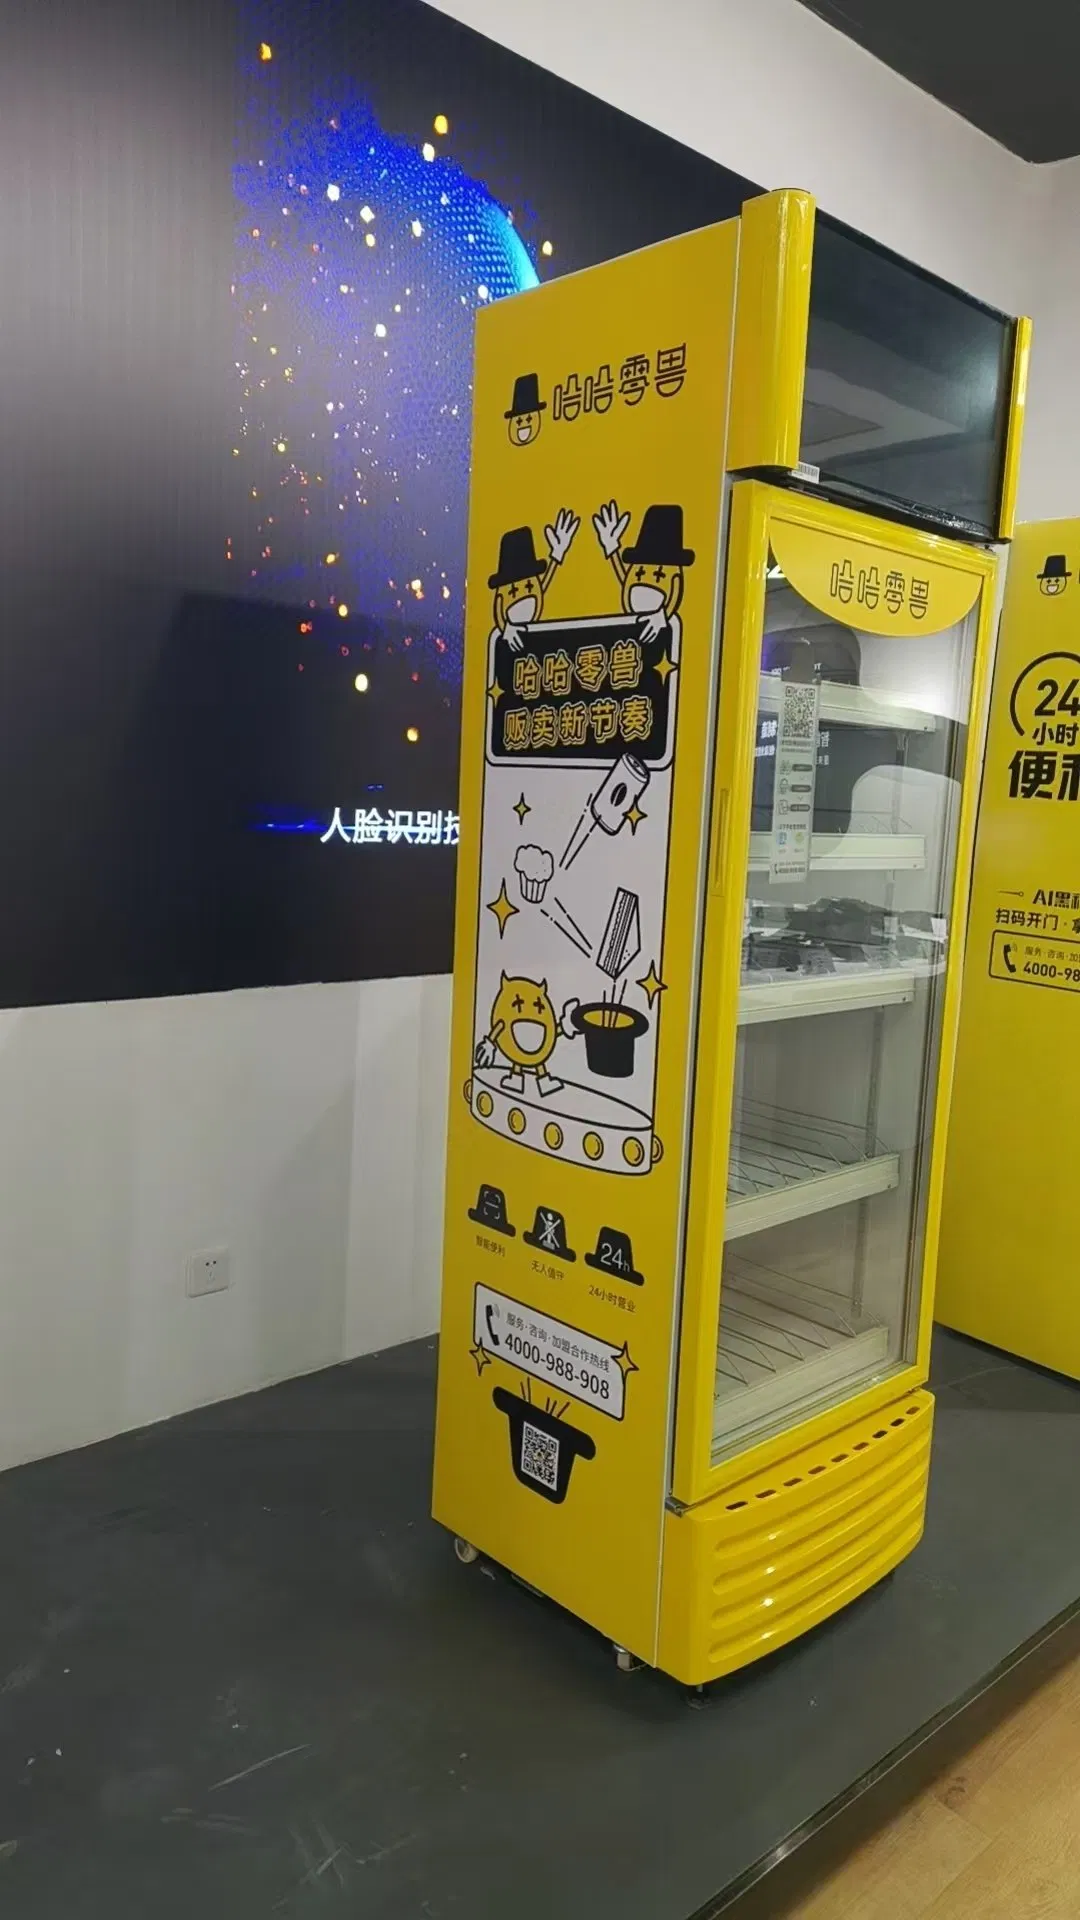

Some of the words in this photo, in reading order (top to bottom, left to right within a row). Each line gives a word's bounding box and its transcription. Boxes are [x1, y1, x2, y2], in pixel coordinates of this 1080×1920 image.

[513, 638, 643, 699] 哈哈零兽
[1034, 678, 1080, 717] 24
[503, 695, 653, 750] 贩卖新节奏
[1032, 722, 1078, 747] 小时
[531, 1260, 565, 1281] 无人值守
[588, 1285, 636, 1314] 24小时营业
[504, 1333, 610, 1400] 4000-988-908
